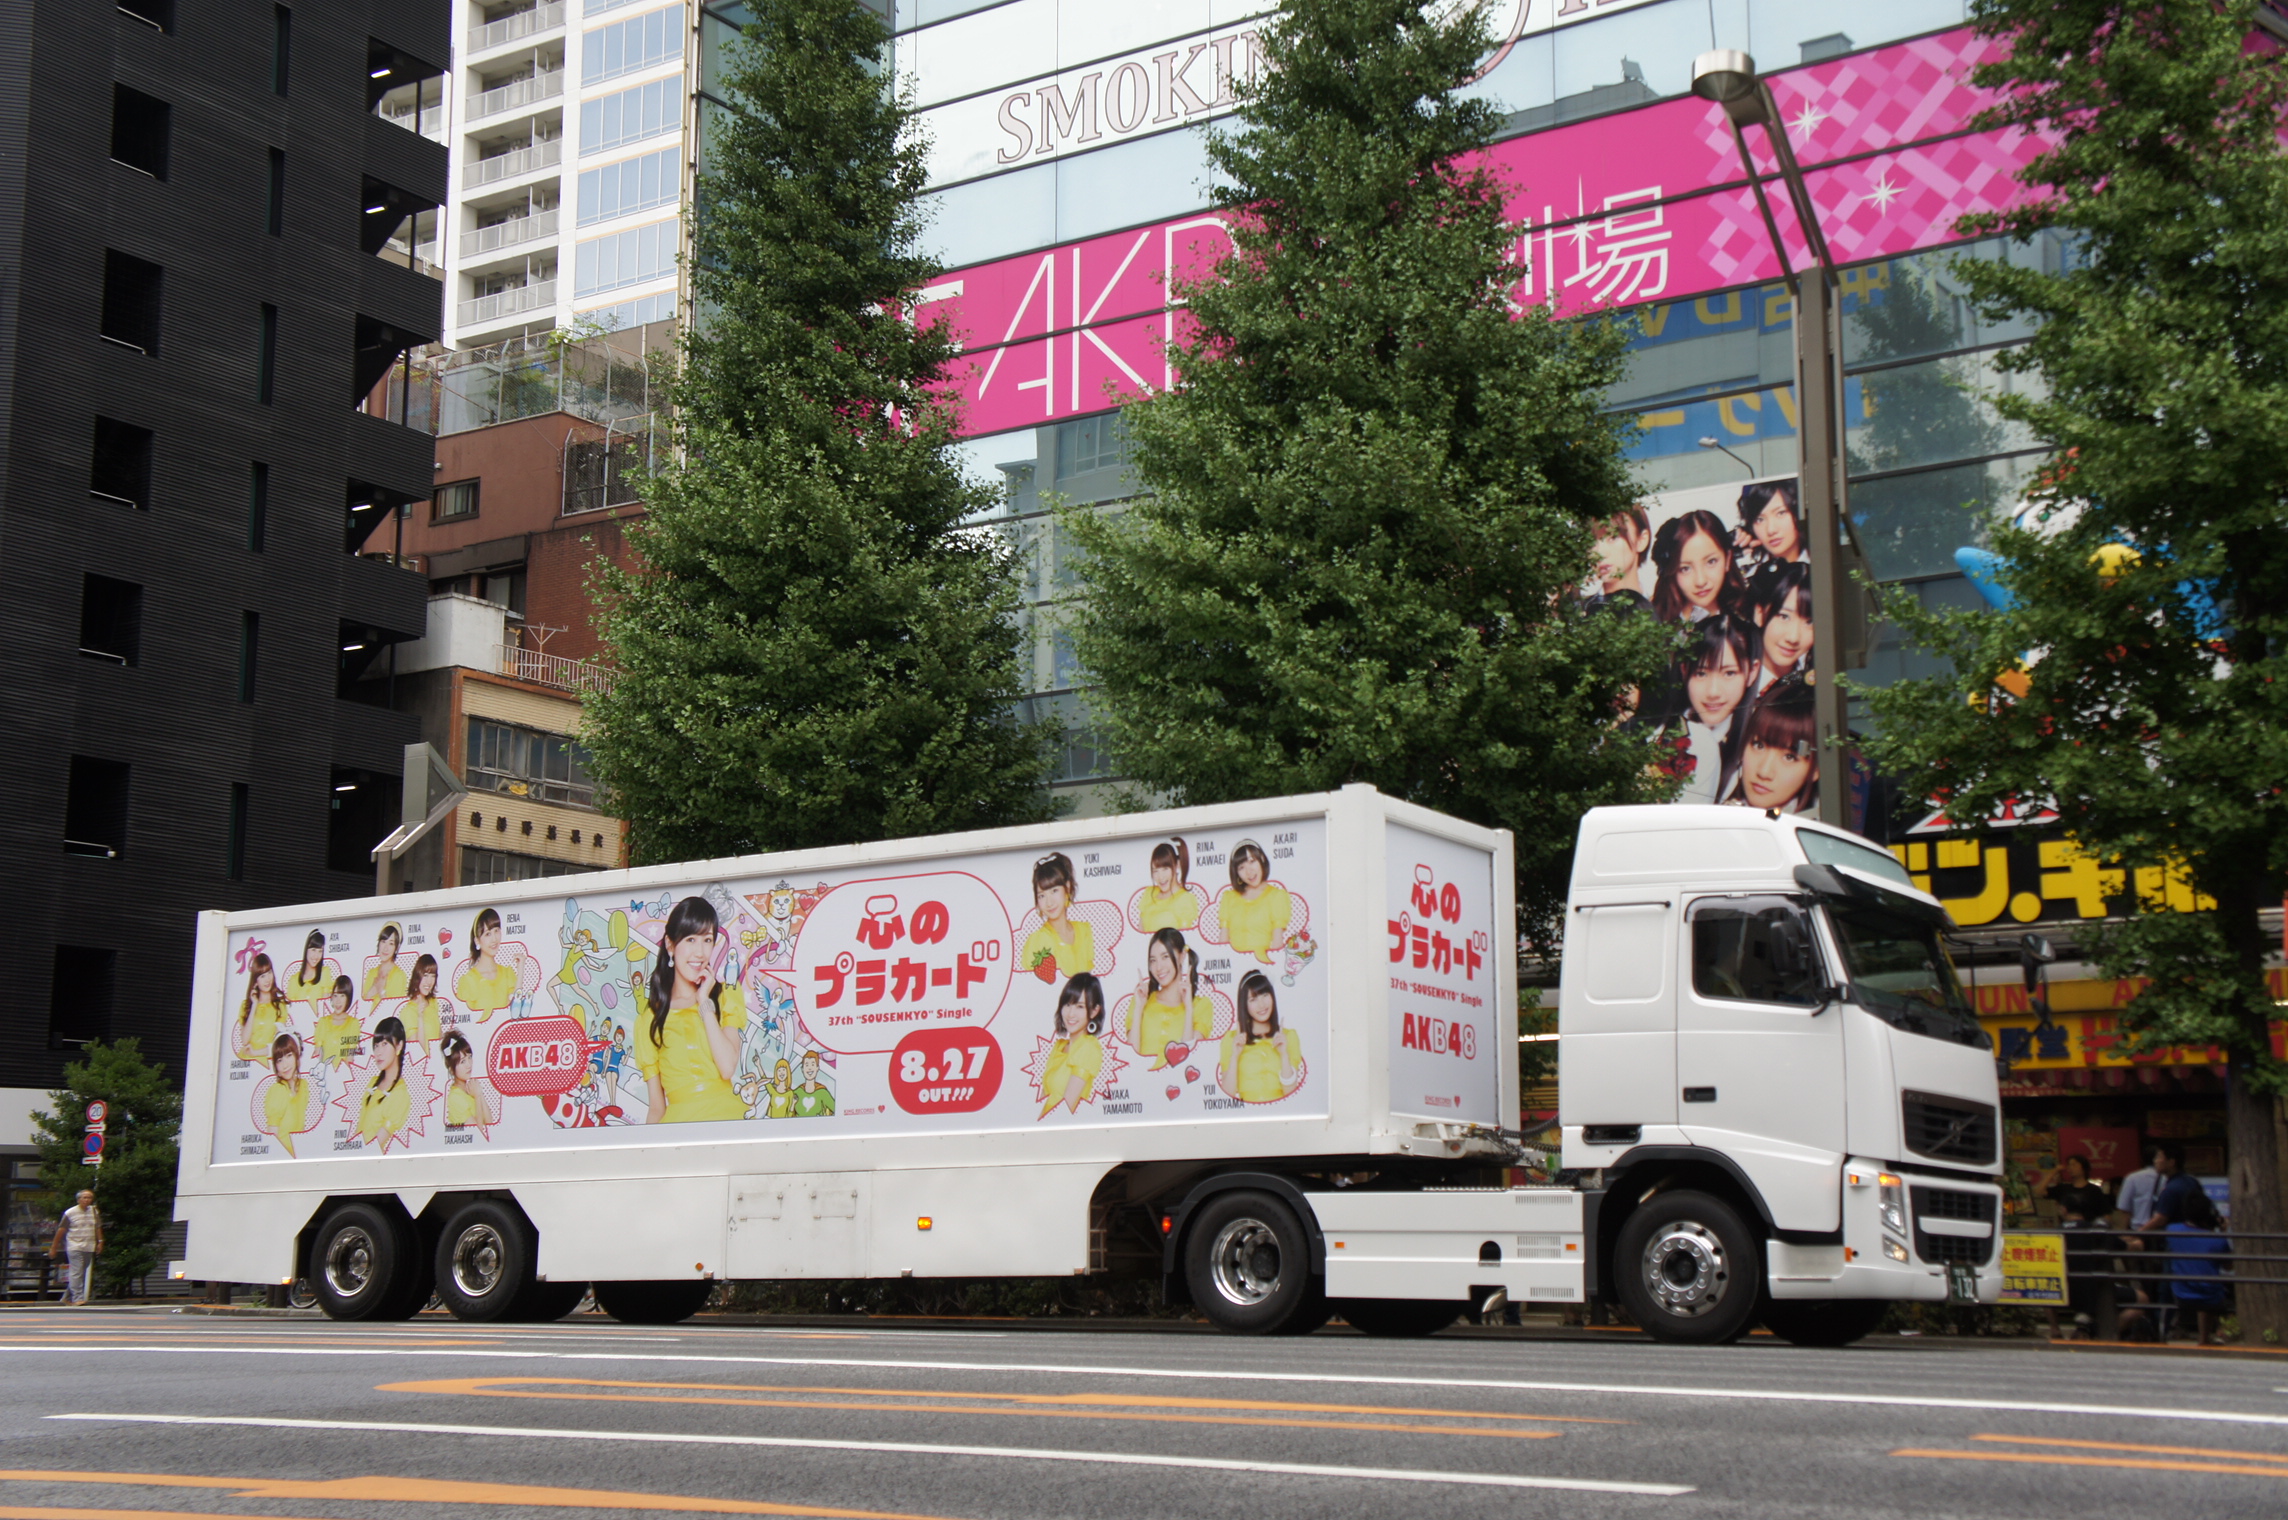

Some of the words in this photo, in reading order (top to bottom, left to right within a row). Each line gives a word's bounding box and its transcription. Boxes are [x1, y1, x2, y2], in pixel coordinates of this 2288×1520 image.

[1273, 832, 1298, 846] AKARI
[1196, 841, 1214, 853] RINA
[1083, 853, 1100, 864] YUKI
[1272, 847, 1294, 860] SUDA
[1196, 854, 1226, 867] KAWAEI
[1083, 864, 1122, 878] KASHIWAGI
[1410, 863, 1461, 924] 心の
[506, 913, 521, 923] RENA
[855, 894, 950, 950] 心の
[408, 924, 421, 934] RINA
[506, 925, 526, 935] MATSUI
[329, 932, 339, 942] AYA
[407, 935, 425, 945] IKOMA
[328, 943, 350, 953] SHIBATA
[1387, 910, 1488, 981] プラカード
[1203, 958, 1231, 971] JURINA
[814, 940, 1000, 1009] プラカード
[1203, 972, 1232, 985] MATSUI
[1390, 977, 1409, 991] 37th
[1460, 993, 1483, 1008] Single
[828, 1015, 854, 1026] 37th
[936, 1007, 973, 1020] Single
[1401, 1012, 1477, 1060] AKB48
[498, 1043, 577, 1071] AKB48
[230, 1060, 250, 1069] HARUNA
[900, 1046, 990, 1083] 8.27
[230, 1070, 249, 1080] KOJIMA
[918, 1086, 974, 1103] OUT!!!
[1102, 1089, 1130, 1101] SAYAKA
[1203, 1084, 1216, 1096] YUI
[1102, 1102, 1143, 1115] YAMAMOTO
[1203, 1097, 1245, 1110] YOKOYAMA
[90, 1106, 104, 1118] 20
[241, 1134, 262, 1144] HARUKA
[334, 1130, 347, 1139] RINO
[444, 1134, 473, 1144] TAKAHASHI
[240, 1146, 269, 1156] SHIMAZAKI
[334, 1141, 362, 1151] SASHIHARA
